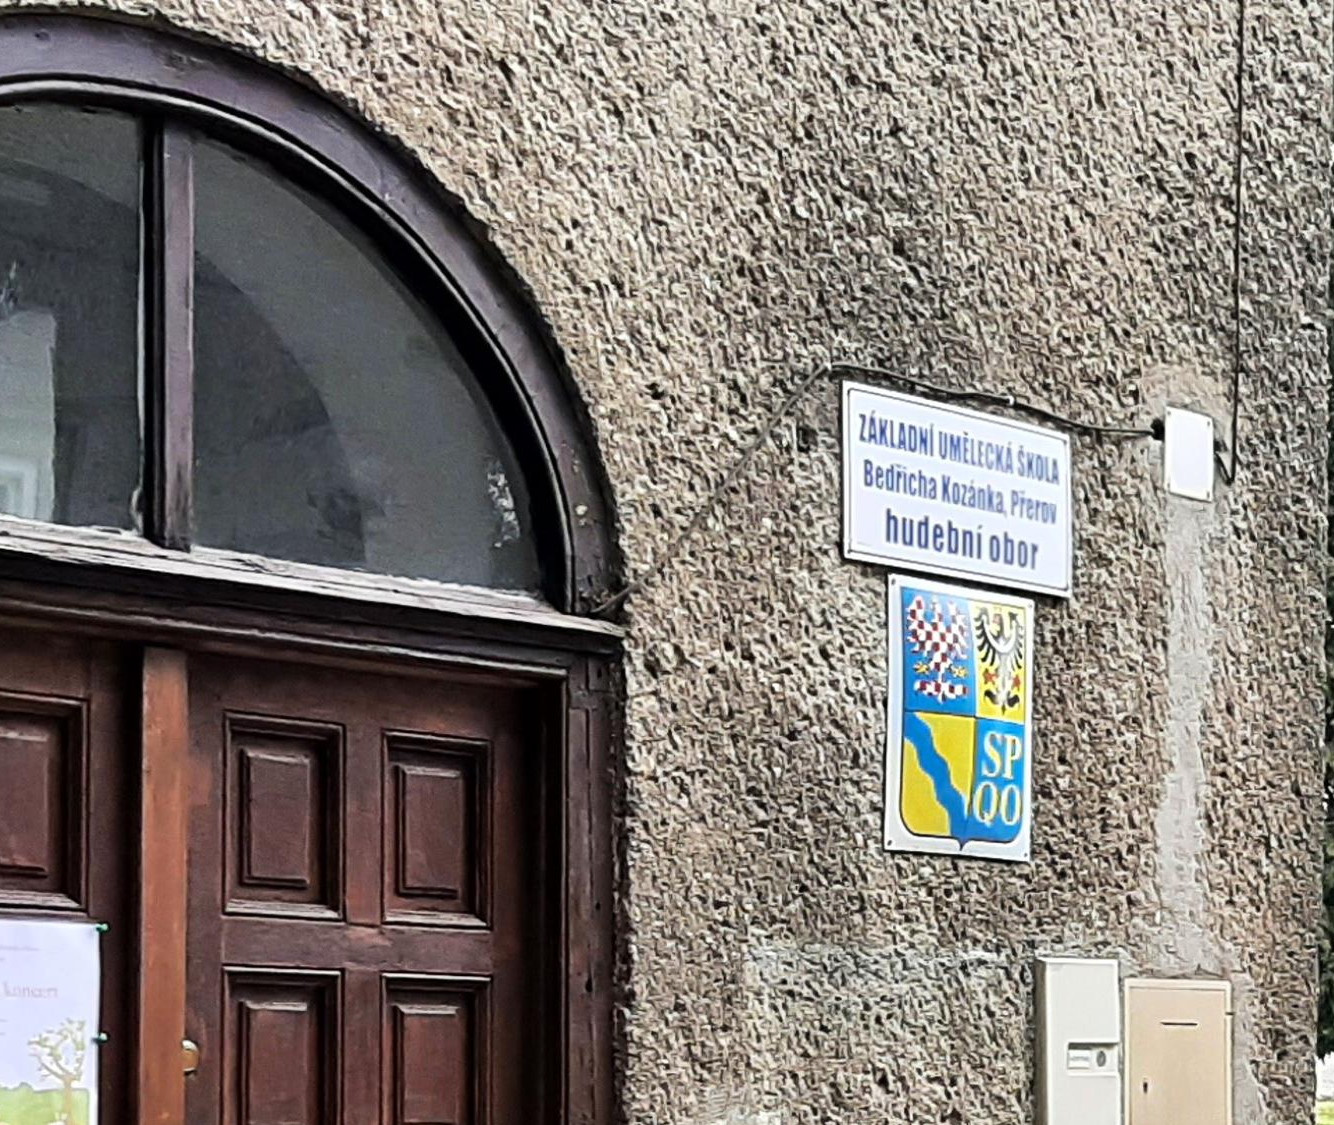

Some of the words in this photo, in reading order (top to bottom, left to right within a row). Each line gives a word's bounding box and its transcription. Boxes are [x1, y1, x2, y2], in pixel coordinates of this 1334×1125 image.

[858, 410, 935, 457] ZÁKLADNÍ
[938, 431, 1014, 475] UMĚLECKÁ
[1017, 446, 1060, 486] ŠKOLA
[863, 459, 937, 500] Bedřicha
[941, 475, 1008, 517] Kozánka,
[1010, 489, 1058, 525] Přerov
[885, 508, 983, 560] hudební
[989, 532, 1039, 570] obor
[981, 731, 1022, 780] SP
